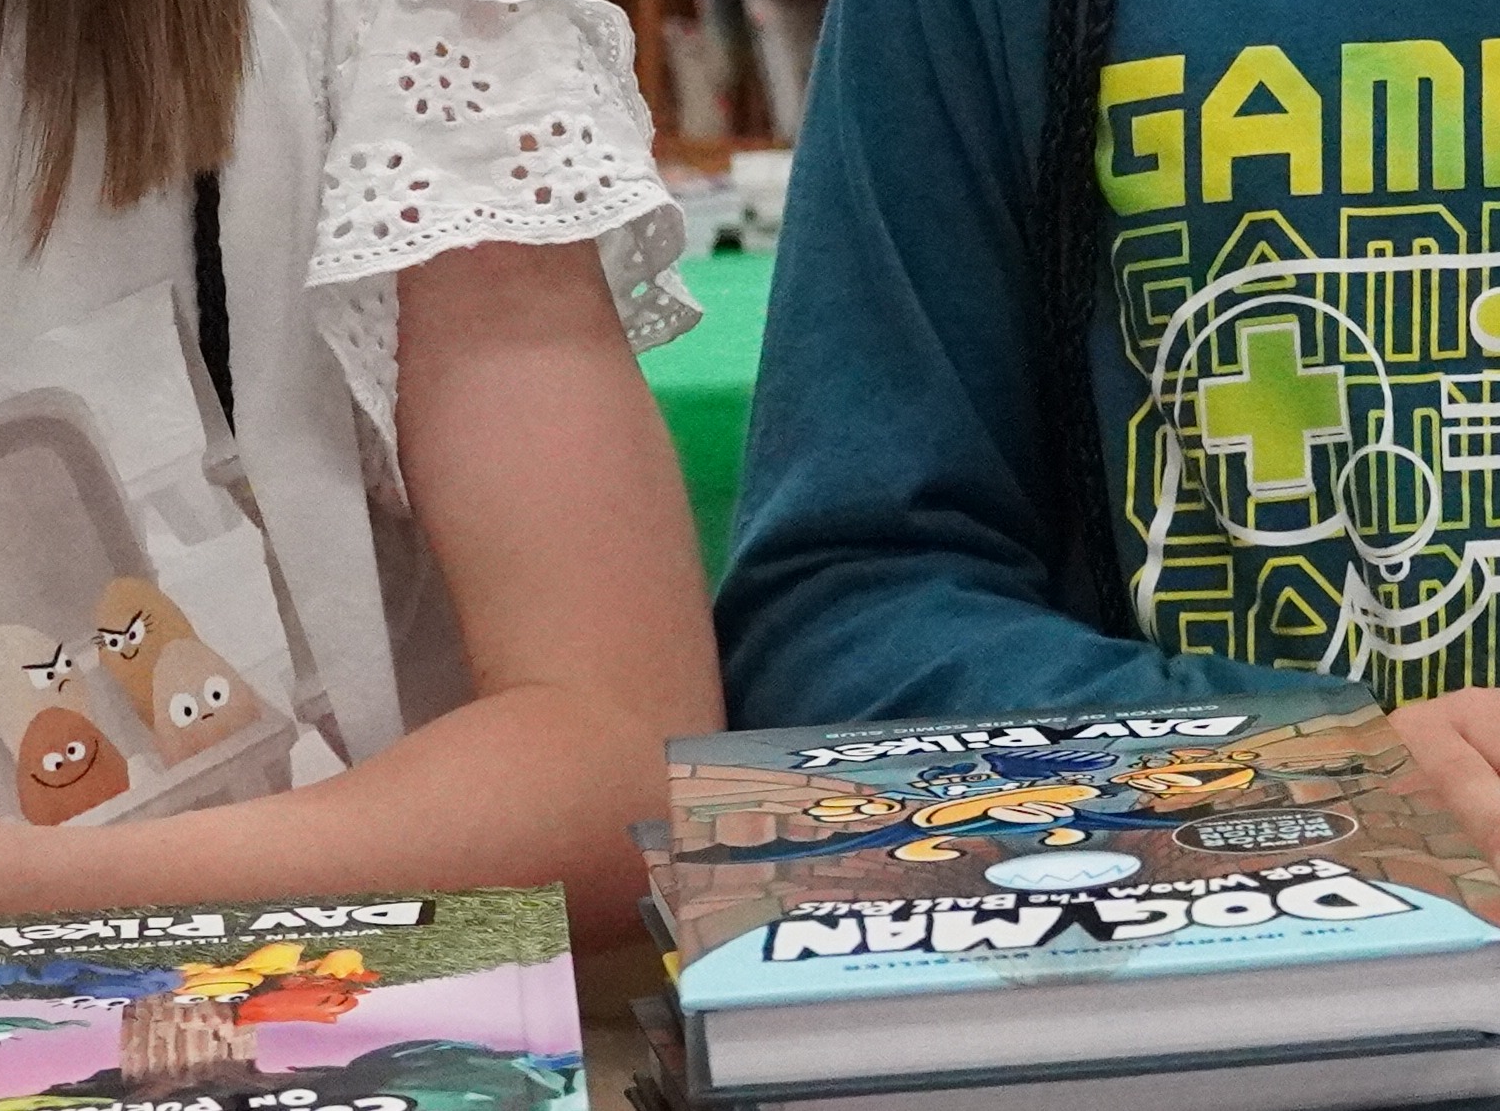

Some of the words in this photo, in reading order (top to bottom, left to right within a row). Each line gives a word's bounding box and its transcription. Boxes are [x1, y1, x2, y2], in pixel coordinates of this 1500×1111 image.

[1077, 713, 1107, 721] OF
[1116, 704, 1219, 718] CREATOR
[893, 723, 968, 735] COMIC
[977, 720, 1014, 729] KID
[1023, 716, 1069, 725] CAT
[1074, 715, 1249, 739] DAV
[825, 730, 883, 740] CLUB
[1196, 816, 1326, 834] PICTURE
[1199, 822, 1331, 840] MOTION
[1202, 828, 1334, 847] MAJOR
[1094, 876, 1415, 939] DOG
[248, 903, 424, 932] DAV
[265, 927, 383, 943] WRITTEN
[770, 907, 1063, 961] MAN
[1300, 926, 1354, 937] THE
[53, 936, 229, 955] ILLUSTRATED
[1046, 932, 1284, 954] INTERNATIONAL
[12, 949, 44, 958] BY
[842, 950, 1030, 971] BESTSELLER
[248, 1088, 318, 1109] ON
